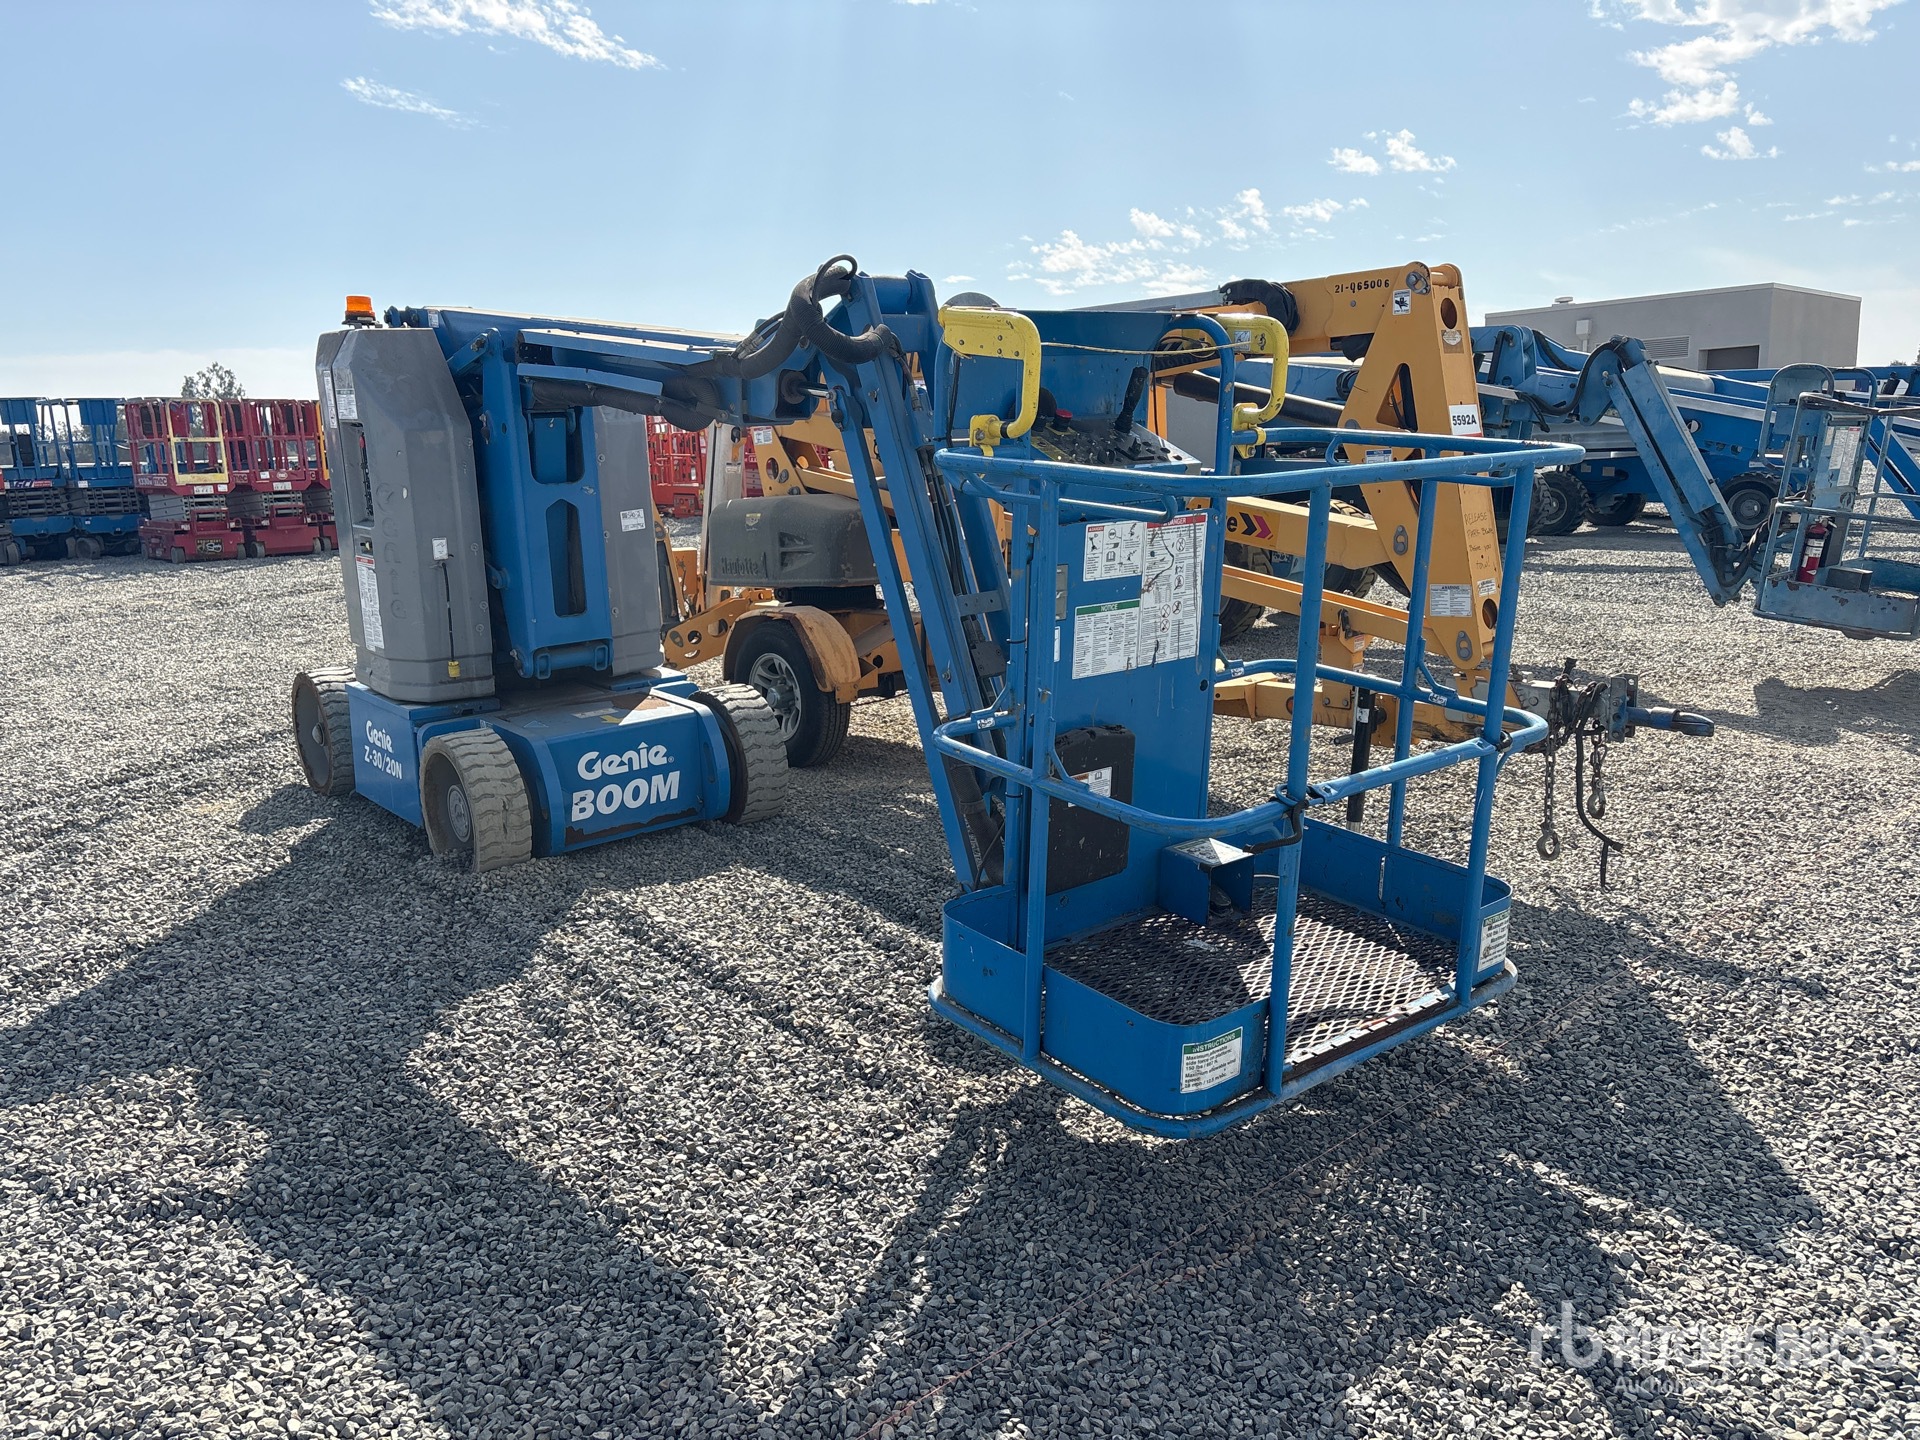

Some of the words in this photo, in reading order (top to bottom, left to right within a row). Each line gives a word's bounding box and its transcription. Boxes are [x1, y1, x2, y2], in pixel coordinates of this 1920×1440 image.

[1452, 414, 1477, 426] 5592A
[1100, 603, 1118, 612] NOTICE
[365, 720, 394, 753] Genie
[364, 745, 402, 779] Z-30/20N
[577, 741, 668, 780] Genie
[571, 770, 681, 822] BOOM
[1192, 1033, 1236, 1053] INSTRUCTIONS
